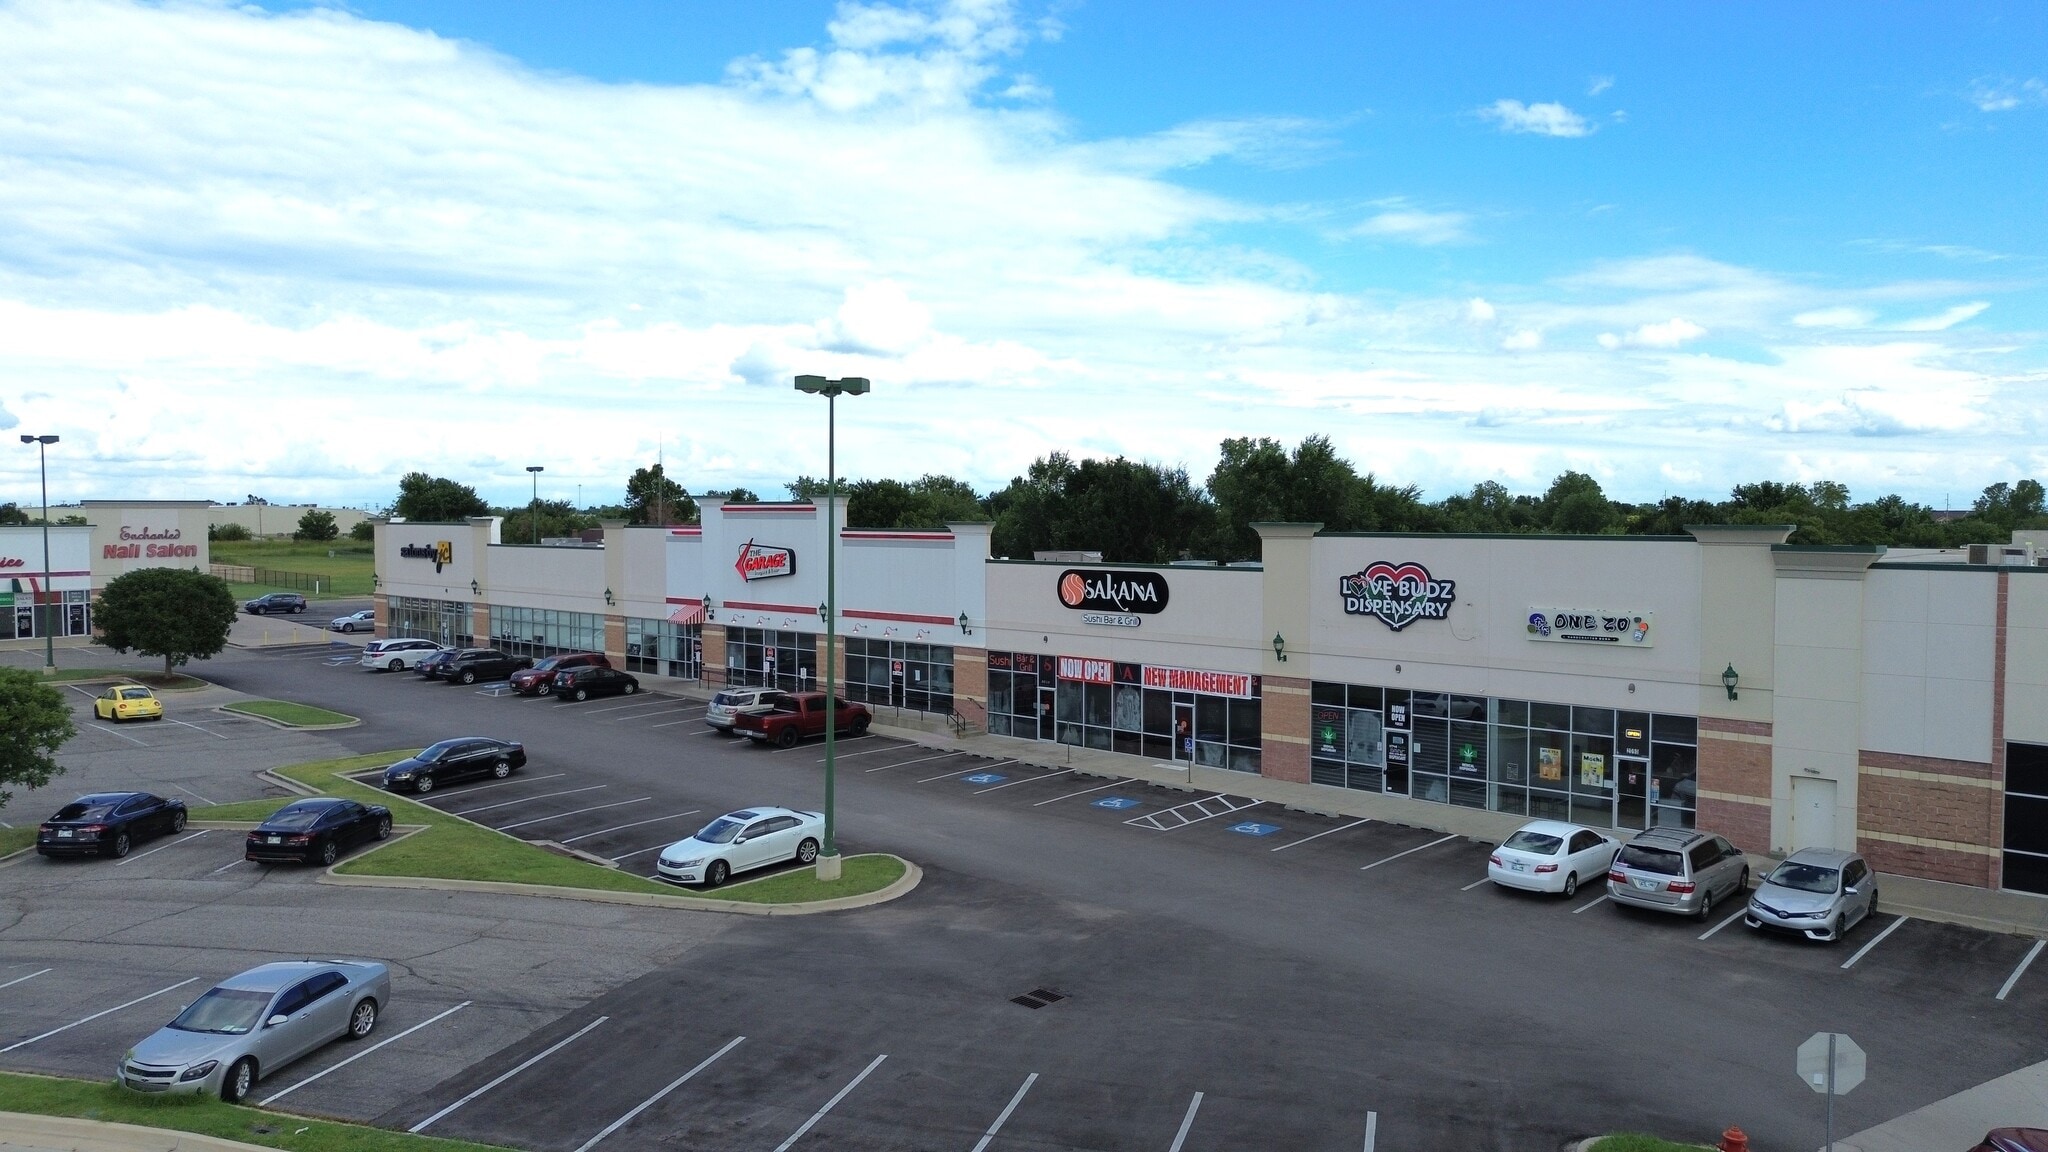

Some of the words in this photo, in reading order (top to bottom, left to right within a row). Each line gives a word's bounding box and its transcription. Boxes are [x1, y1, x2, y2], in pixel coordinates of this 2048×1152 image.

[119, 525, 181, 541] Enchanted
[103, 543, 141, 559] Nail
[146, 543, 198, 558] Salon
[750, 549, 762, 557] THE
[0, 557, 25, 568] ice
[745, 553, 787, 571] GARAGE
[1399, 581, 1452, 599] BUDZ
[1347, 597, 1448, 617] DISPENSARY
[1083, 614, 1103, 623] Sushi
[1104, 615, 1116, 624] Bar
[1117, 616, 1124, 625] &
[1124, 616, 1138, 626] Grill
[1554, 613, 1597, 630] ONE
[1602, 616, 1631, 632] ZO
[1016, 653, 1028, 664] Bar
[1029, 654, 1035, 664] &
[1019, 662, 1033, 672] Grill
[1060, 658, 1083, 679] NOW
[1084, 660, 1111, 682] OPEN
[1144, 666, 1167, 687] NEW
[1169, 669, 1249, 696] MANAGEMENT
[1317, 711, 1340, 720] OPEN
[1391, 704, 1405, 714] NOW
[1391, 713, 1406, 722] OPEN
